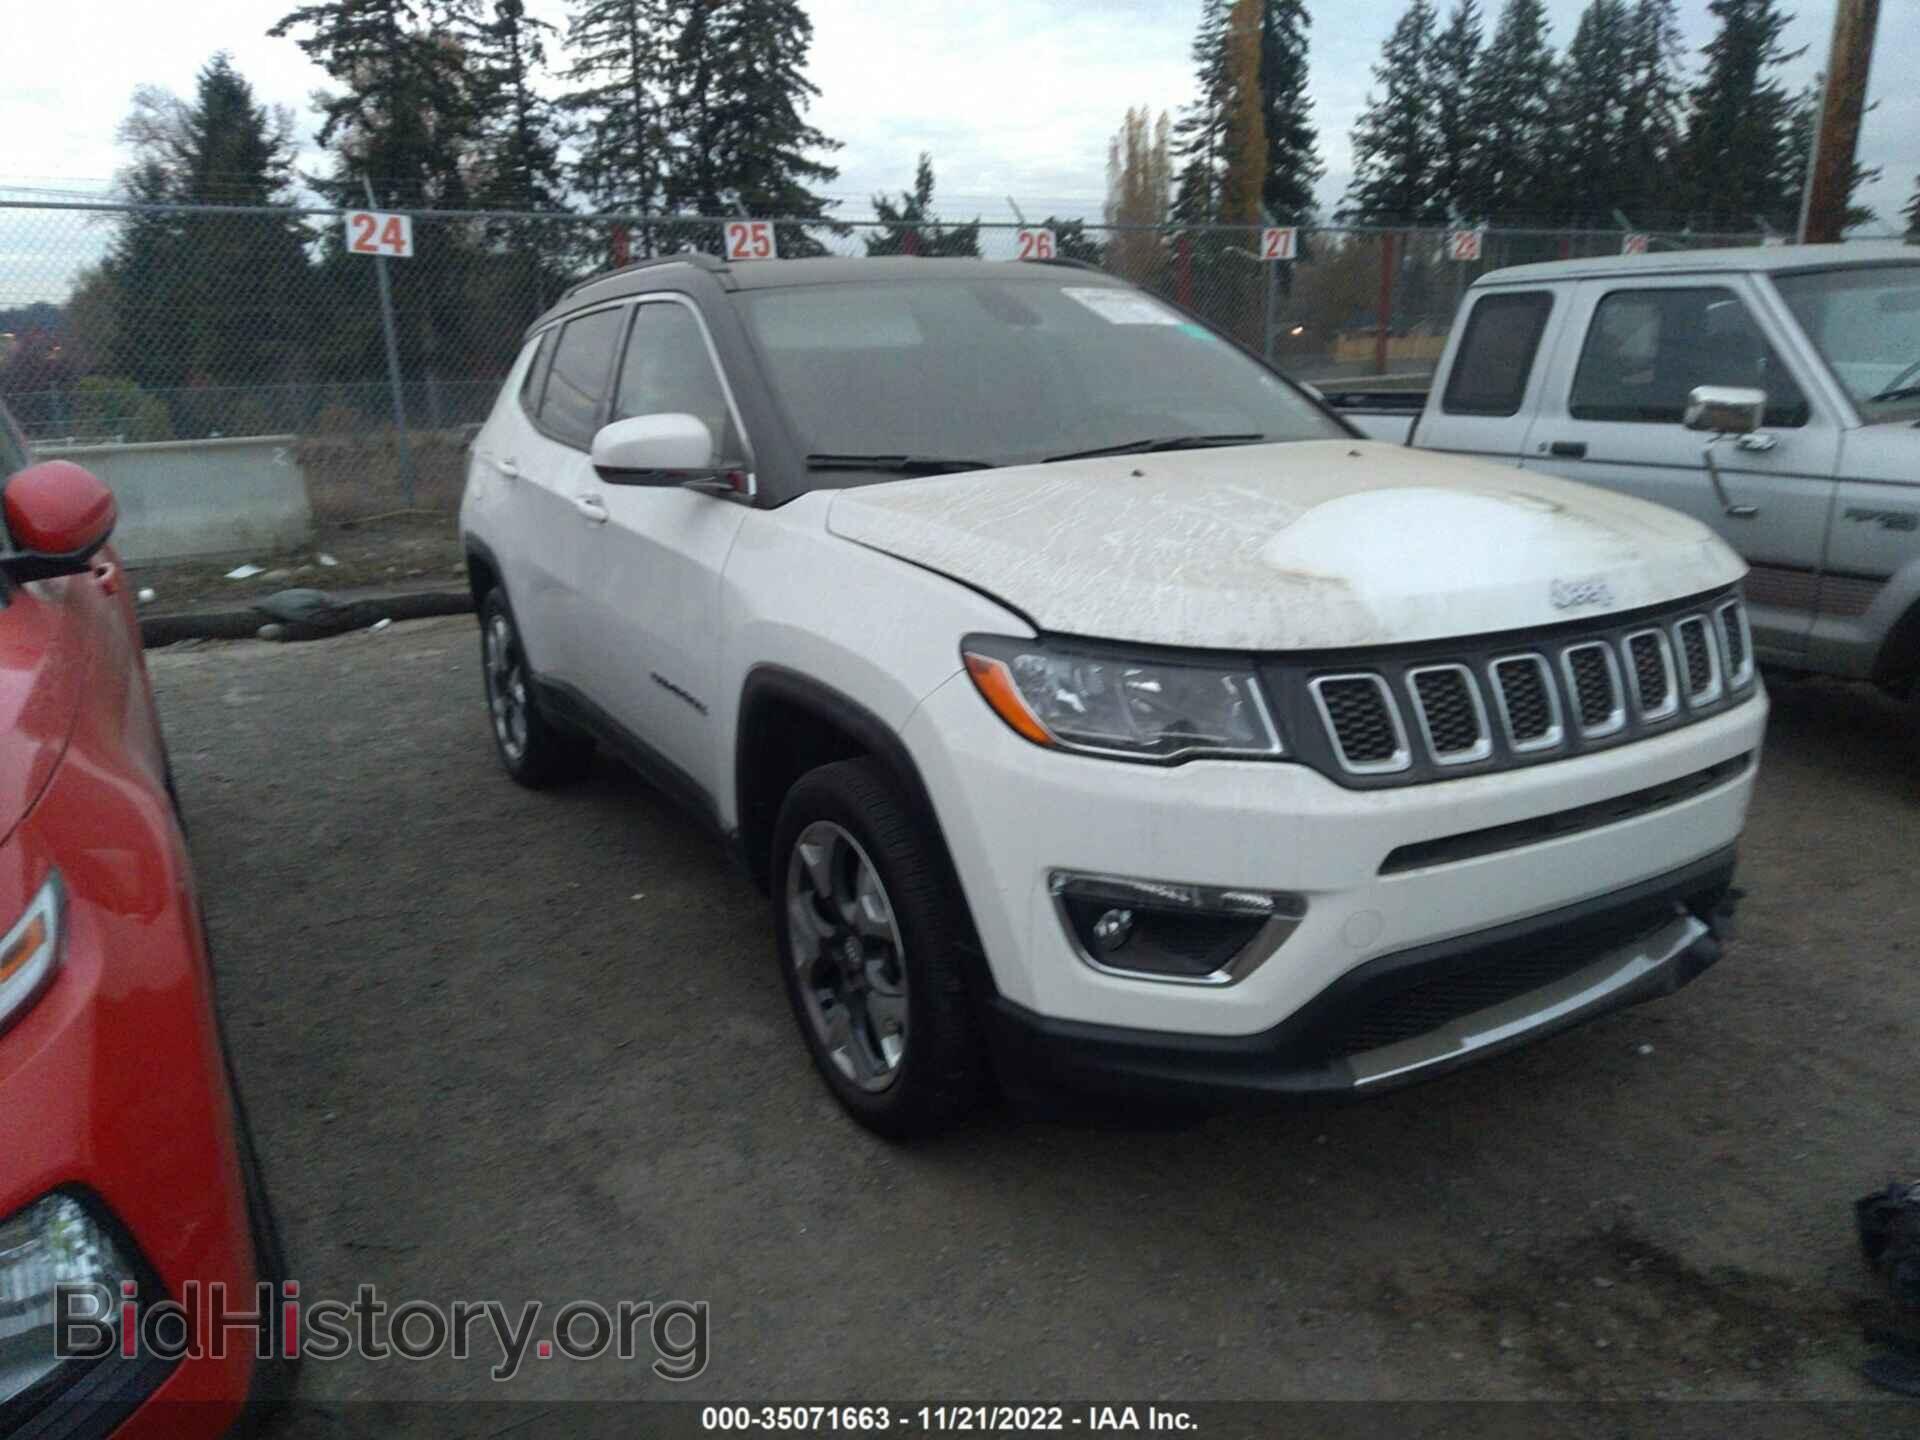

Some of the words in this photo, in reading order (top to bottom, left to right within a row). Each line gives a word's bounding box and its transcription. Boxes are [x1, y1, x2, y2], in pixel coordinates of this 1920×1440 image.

[352, 213, 406, 253] 24
[730, 223, 769, 257] 25
[1019, 231, 1051, 259] 26
[1266, 230, 1290, 257] 27
